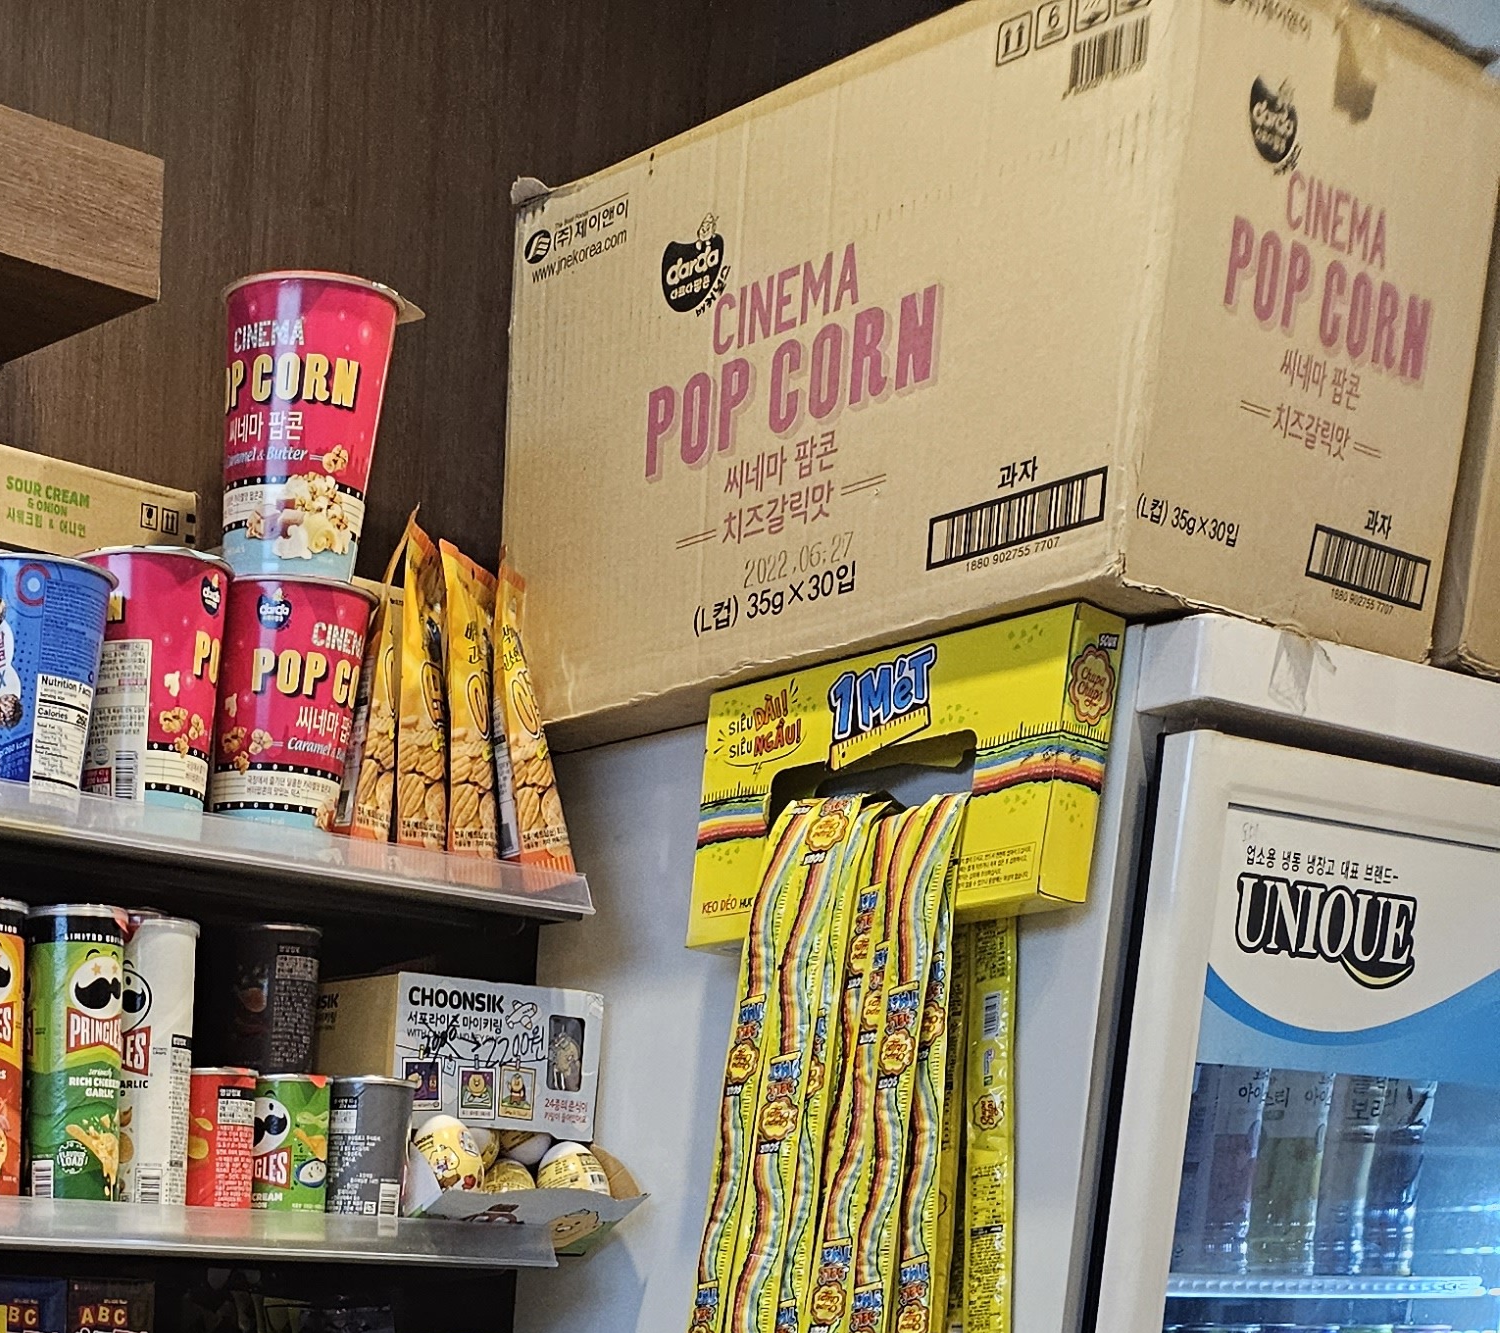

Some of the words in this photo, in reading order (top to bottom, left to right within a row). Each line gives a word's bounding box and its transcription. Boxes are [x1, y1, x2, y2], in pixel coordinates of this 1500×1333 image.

[1286, 169, 1387, 271] CINEMA
[666, 246, 720, 287] darda
[711, 241, 859, 356] CINEMA
[1224, 216, 1311, 331] POP
[1317, 260, 1433, 386] CORN
[233, 316, 305, 353] CINEMA
[250, 354, 361, 410] CORN
[643, 355, 756, 482] POP
[767, 283, 946, 438] CORN
[1331, 364, 1362, 411] 팝콘
[268, 410, 304, 441] 팝콘
[267, 445, 309, 463] Butter
[723, 445, 788, 496] 씨네마
[795, 431, 839, 478] 팝콘
[997, 456, 1040, 489] 과자
[5, 474, 41, 499] SOUR
[44, 482, 91, 509] CREAM
[40, 499, 68, 518] ONION
[720, 485, 836, 545] 치즈갈릭맛
[1363, 507, 1392, 539] 과자
[259, 602, 290, 616] darda
[693, 598, 741, 636] (L컵)
[41, 676, 77, 692] Nutrition
[251, 648, 331, 698] POP
[37, 707, 69, 721] Calories
[296, 705, 340, 736] 씨네마
[728, 717, 753, 736] SIÊU
[288, 737, 332, 757] Caramel
[728, 740, 753, 759] SIÊU
[1246, 845, 1276, 869] 업소용
[1282, 851, 1301, 873] 냉동
[1307, 854, 1335, 876] 냉장고
[1341, 860, 1360, 881] 대표
[1236, 872, 1417, 989] UNIQUE
[408, 986, 505, 1014] CHOONSIK
[462, 1016, 503, 1034] 마이키링
[68, 1076, 91, 1088] RICH
[85, 1088, 115, 1099] GARLIC
[79, 1303, 128, 1328] ABC
